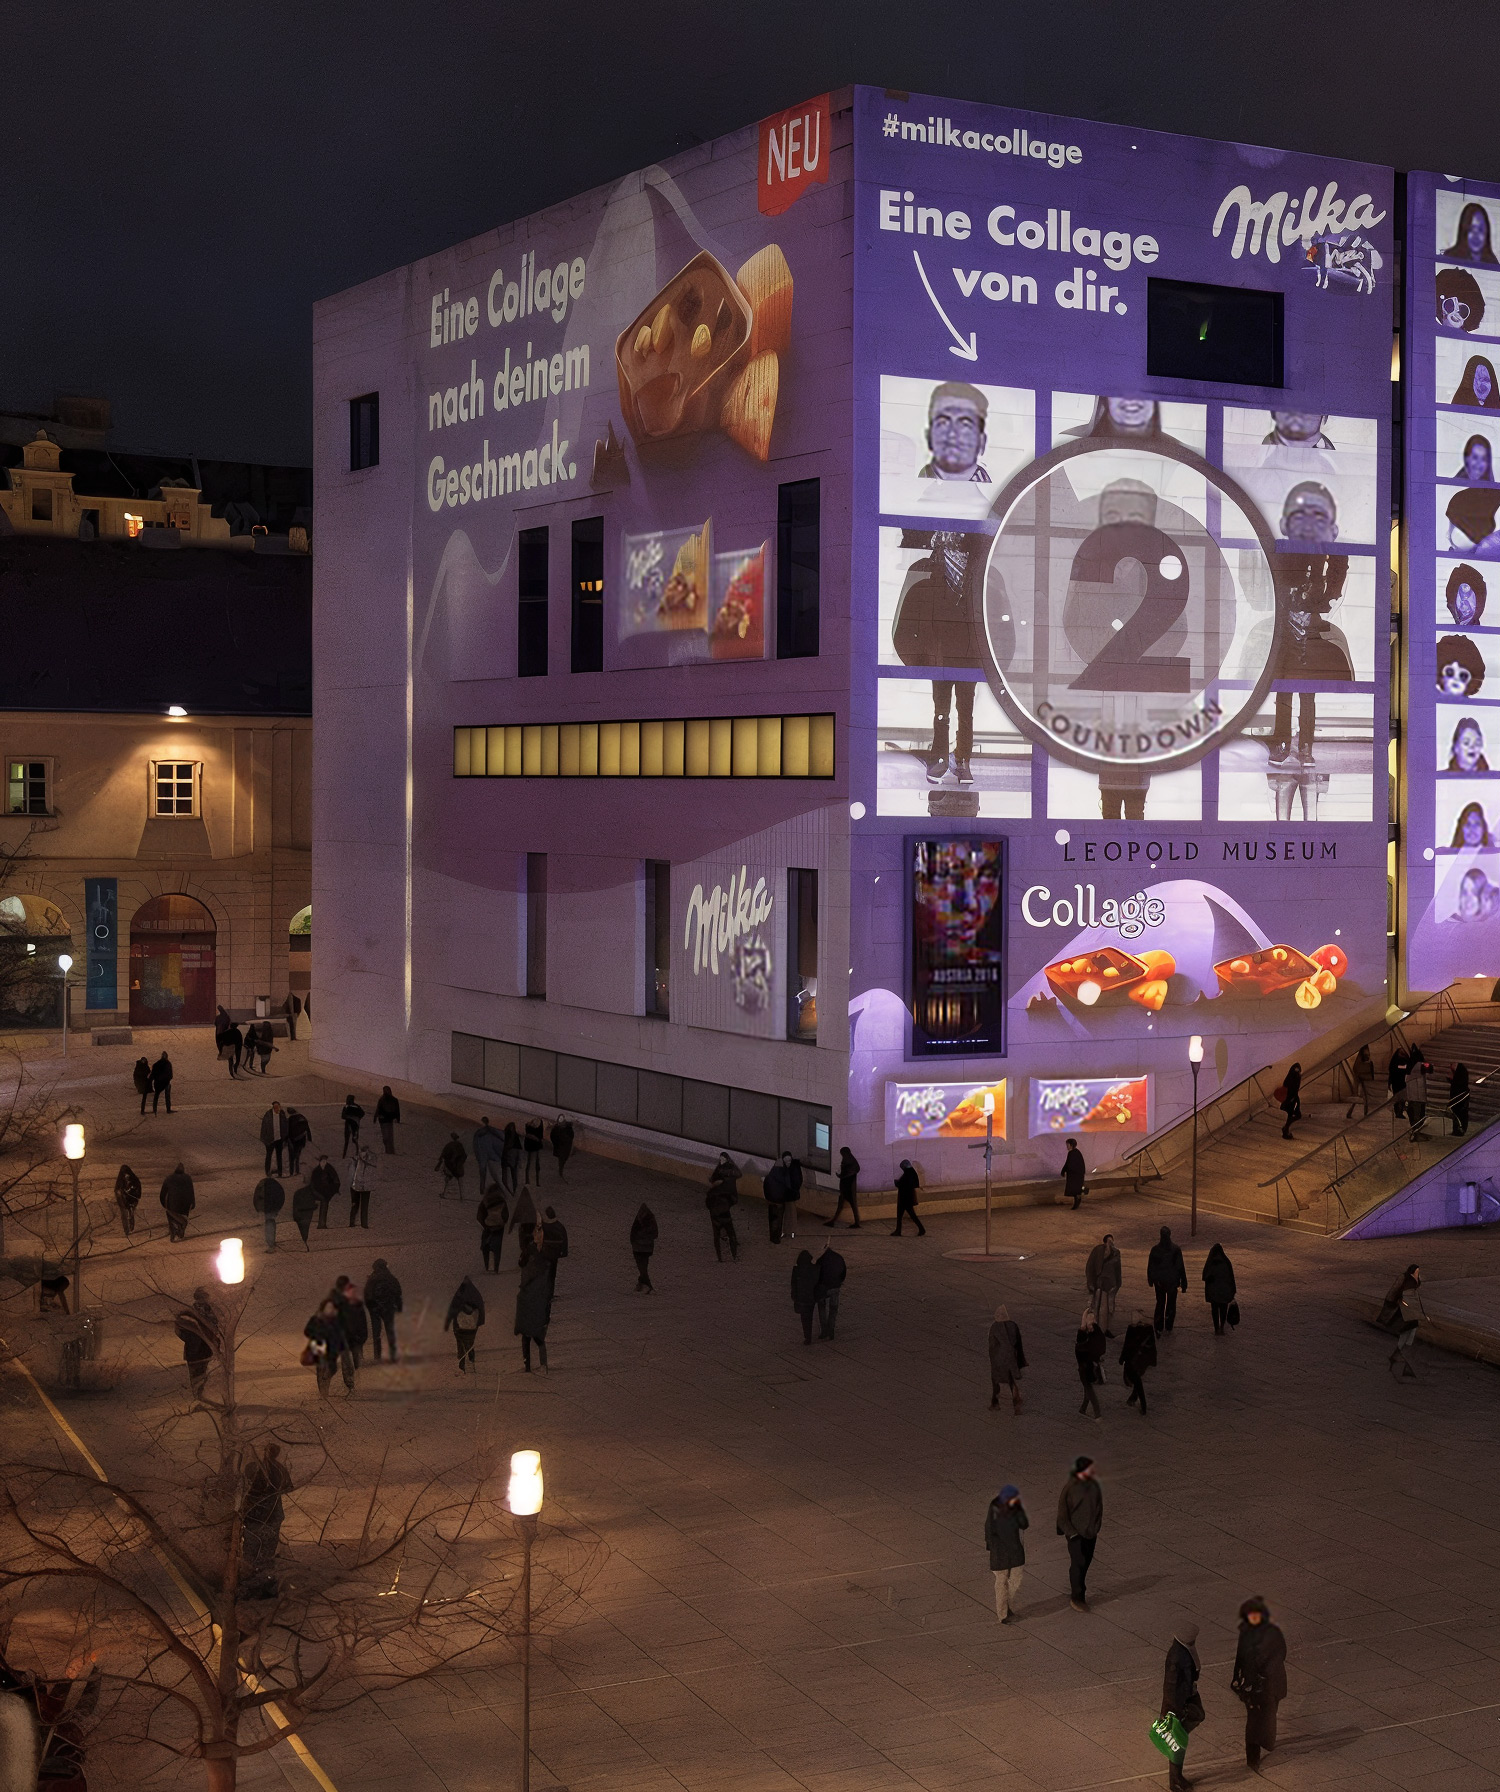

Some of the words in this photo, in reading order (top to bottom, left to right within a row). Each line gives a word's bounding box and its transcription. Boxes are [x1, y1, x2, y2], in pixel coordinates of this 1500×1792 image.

[766, 111, 821, 186] NEU
[882, 113, 1083, 168] #milkacollage
[880, 190, 971, 240] Eine
[988, 205, 1160, 271] Collage
[1212, 181, 1386, 264] Milka
[430, 288, 478, 349] Eine
[487, 250, 585, 328] Collage
[952, 267, 1038, 304] von
[1055, 268, 1128, 315] dir.
[429, 360, 484, 430] nach
[494, 343, 590, 411] deinem
[427, 418, 577, 512] Geschmack.
[1067, 521, 1191, 693] 2
[1036, 700, 1225, 754] COUNTDOWN
[1064, 841, 1199, 862] LEOPOLD
[1223, 842, 1338, 861] MUSEUM
[684, 865, 773, 976] Milka
[1021, 884, 1166, 940] Collage
